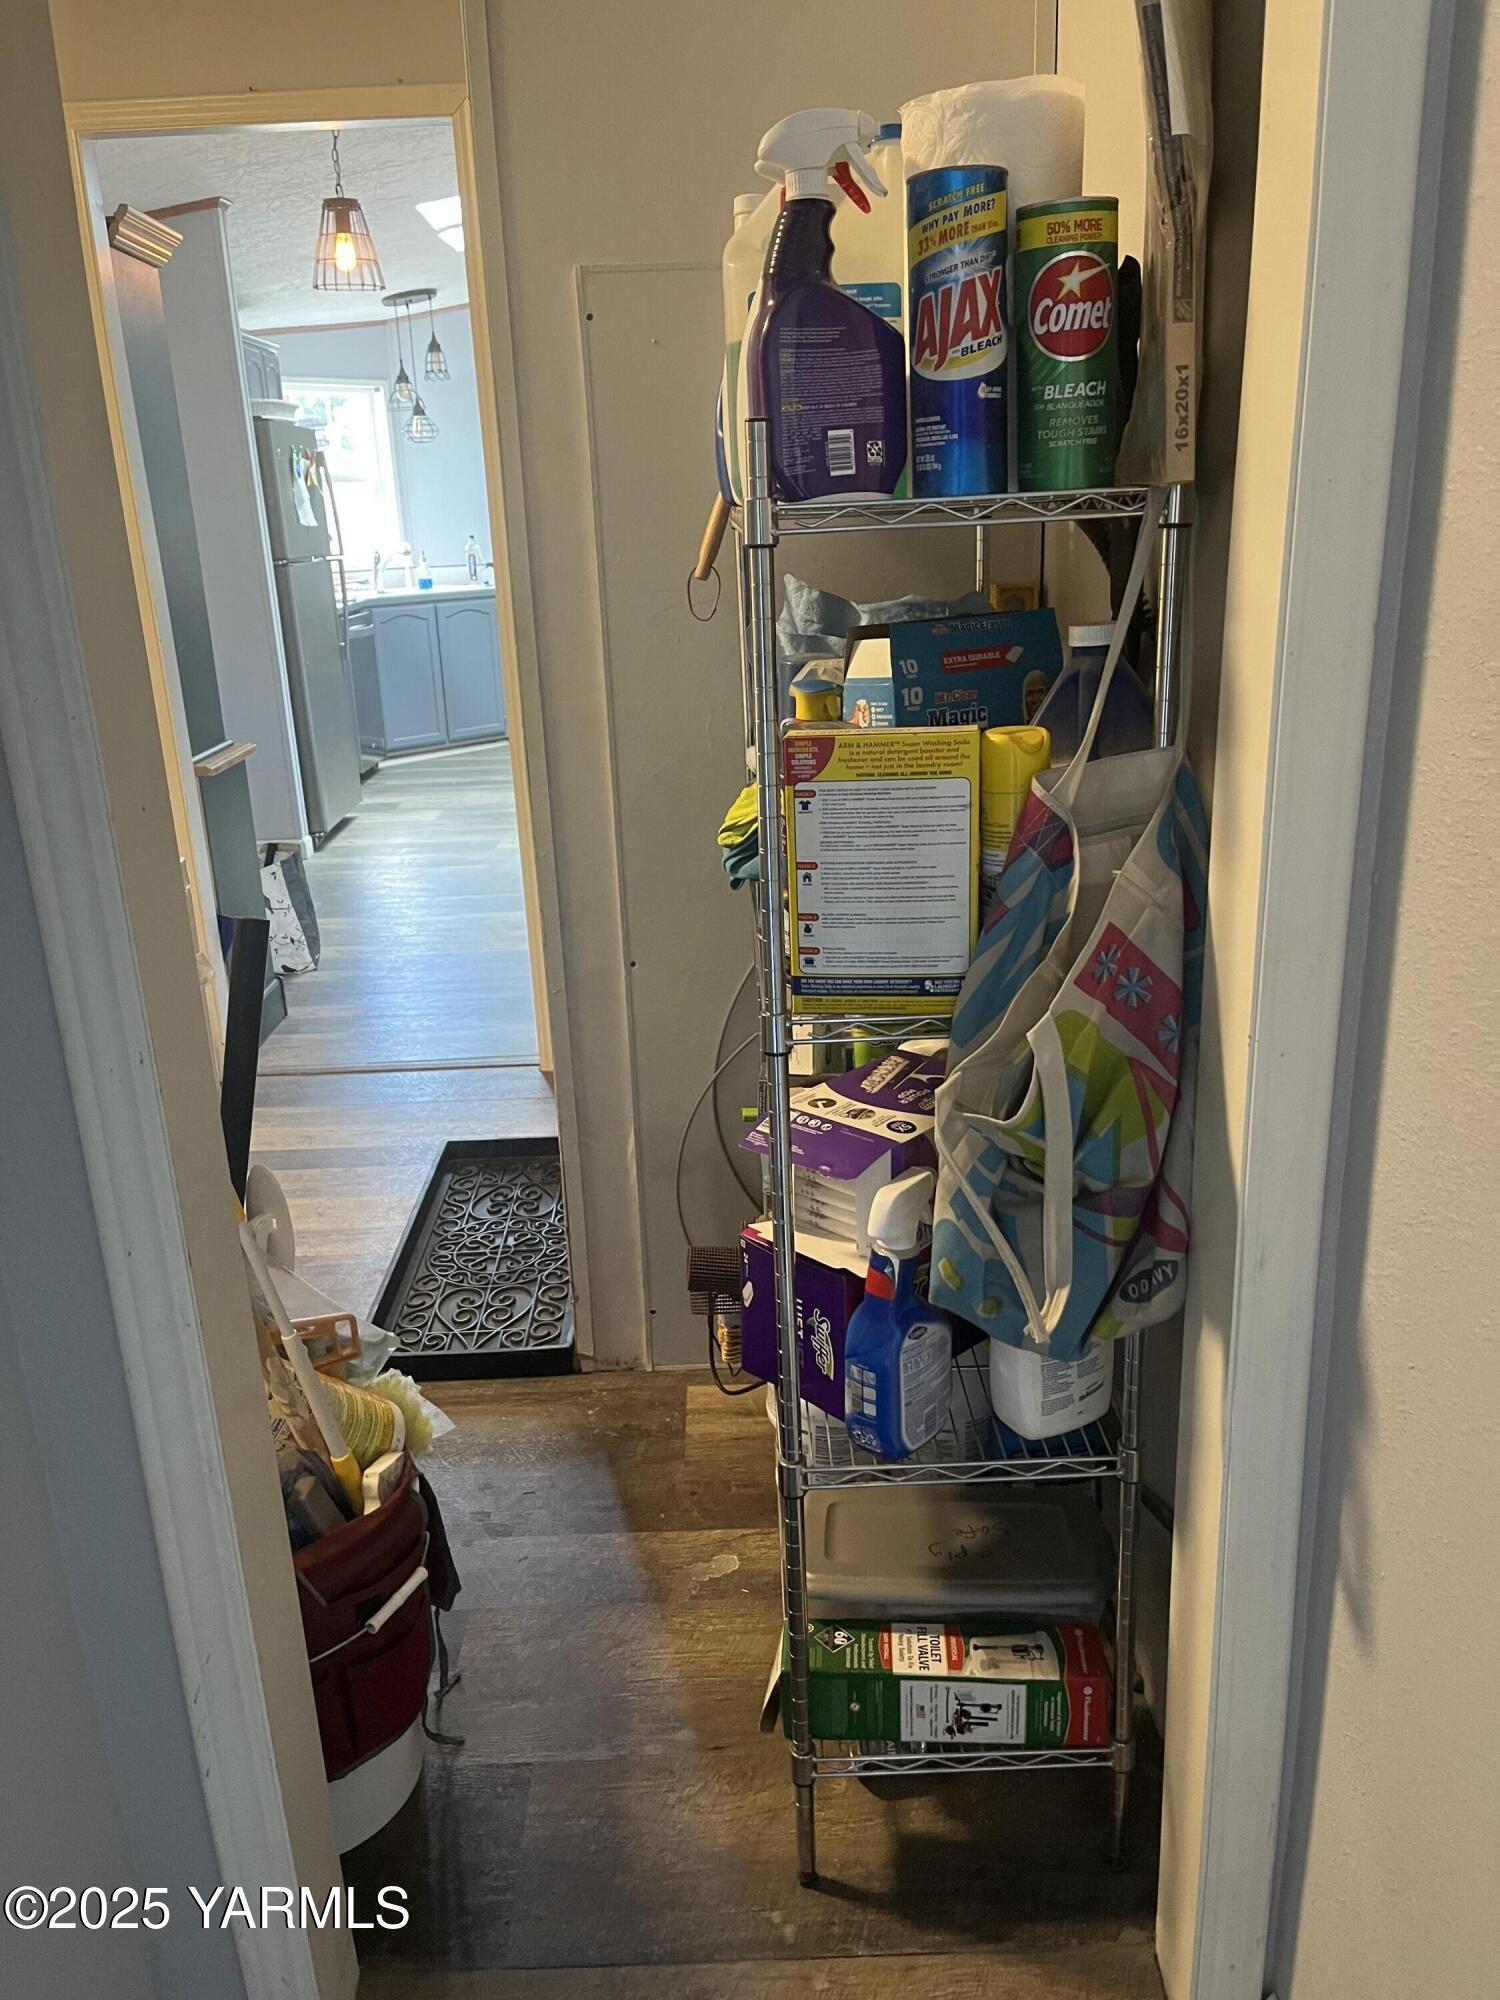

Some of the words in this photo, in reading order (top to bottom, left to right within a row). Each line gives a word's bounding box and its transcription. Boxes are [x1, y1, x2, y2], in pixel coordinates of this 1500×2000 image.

[928, 190, 964, 211] SCRATCH
[966, 183, 985, 196] FREE
[922, 219, 939, 234] WHY
[942, 210, 959, 225] PAY
[964, 198, 996, 218] MORE?
[1073, 218, 1103, 232] MORE
[938, 221, 970, 246] MORE
[971, 223, 986, 232] THAN
[1046, 233, 1079, 244] CLEANING
[960, 257, 979, 269] THAN
[914, 266, 1003, 372] AJAX
[1033, 296, 1113, 335] Comet
[960, 334, 1003, 357] BLEACH
[1044, 381, 1107, 400] BLEACH
[1174, 364, 1189, 452] 16x20x1
[1049, 414, 1099, 427] REMOVES
[1037, 428, 1076, 439] TOUGH
[1077, 425, 1107, 437] STAINS
[1048, 438, 1082, 448] SCRATCH
[899, 659, 919, 675] 10
[943, 654, 968, 666] EXTRA
[901, 686, 924, 707] 10
[927, 702, 989, 727] Magic
[862, 748, 886, 756] natural
[887, 748, 919, 756] detergent
[901, 740, 920, 748] Super
[922, 739, 952, 748] Washing
[916, 761, 941, 770] laundry
[810, 1307, 832, 1377] Swiffer
[834, 1631, 848, 1645] 60
[917, 1626, 928, 1643] FILL
[918, 1644, 930, 1671] VALVE
[930, 1634, 942, 1664] TOILET
